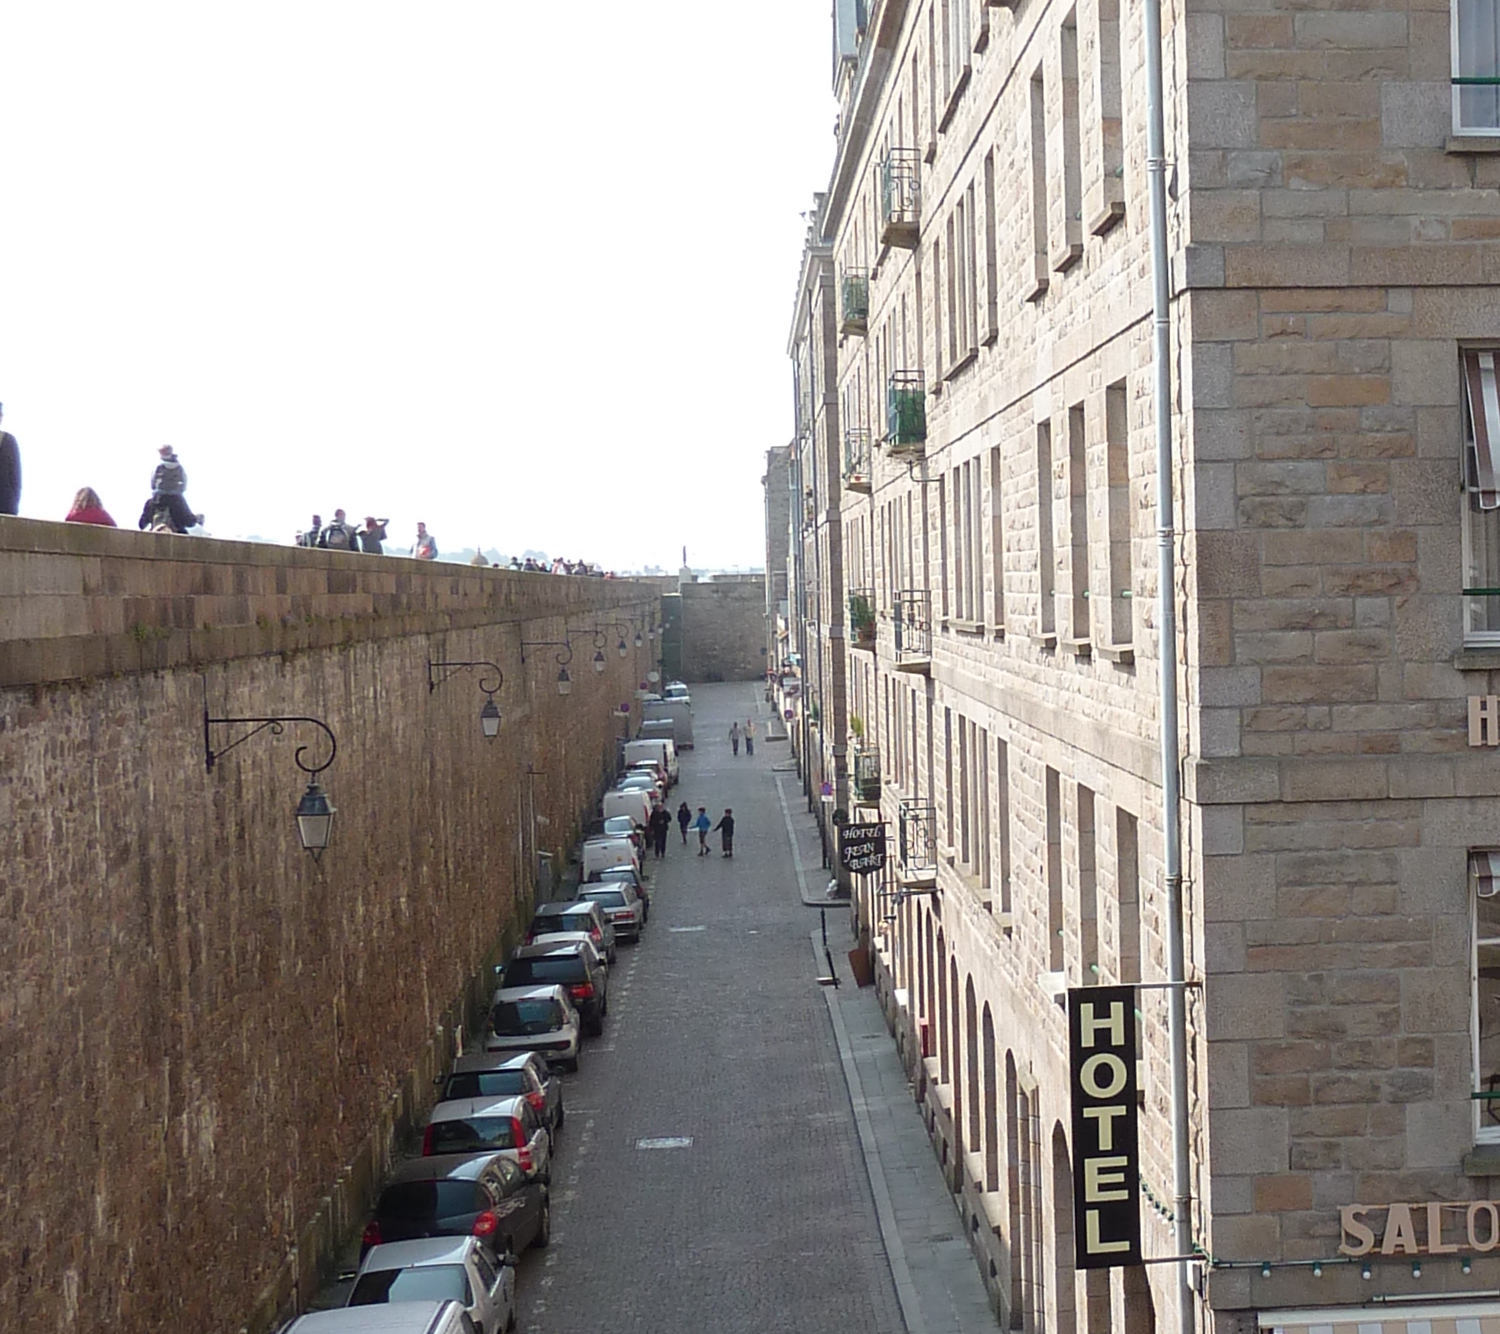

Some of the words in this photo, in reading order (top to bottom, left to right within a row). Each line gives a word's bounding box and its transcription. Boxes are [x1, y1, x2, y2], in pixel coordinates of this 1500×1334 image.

[843, 826, 881, 839] HOTEL
[844, 842, 875, 863] JEAN
[1079, 1001, 1131, 1254] HOTEL
